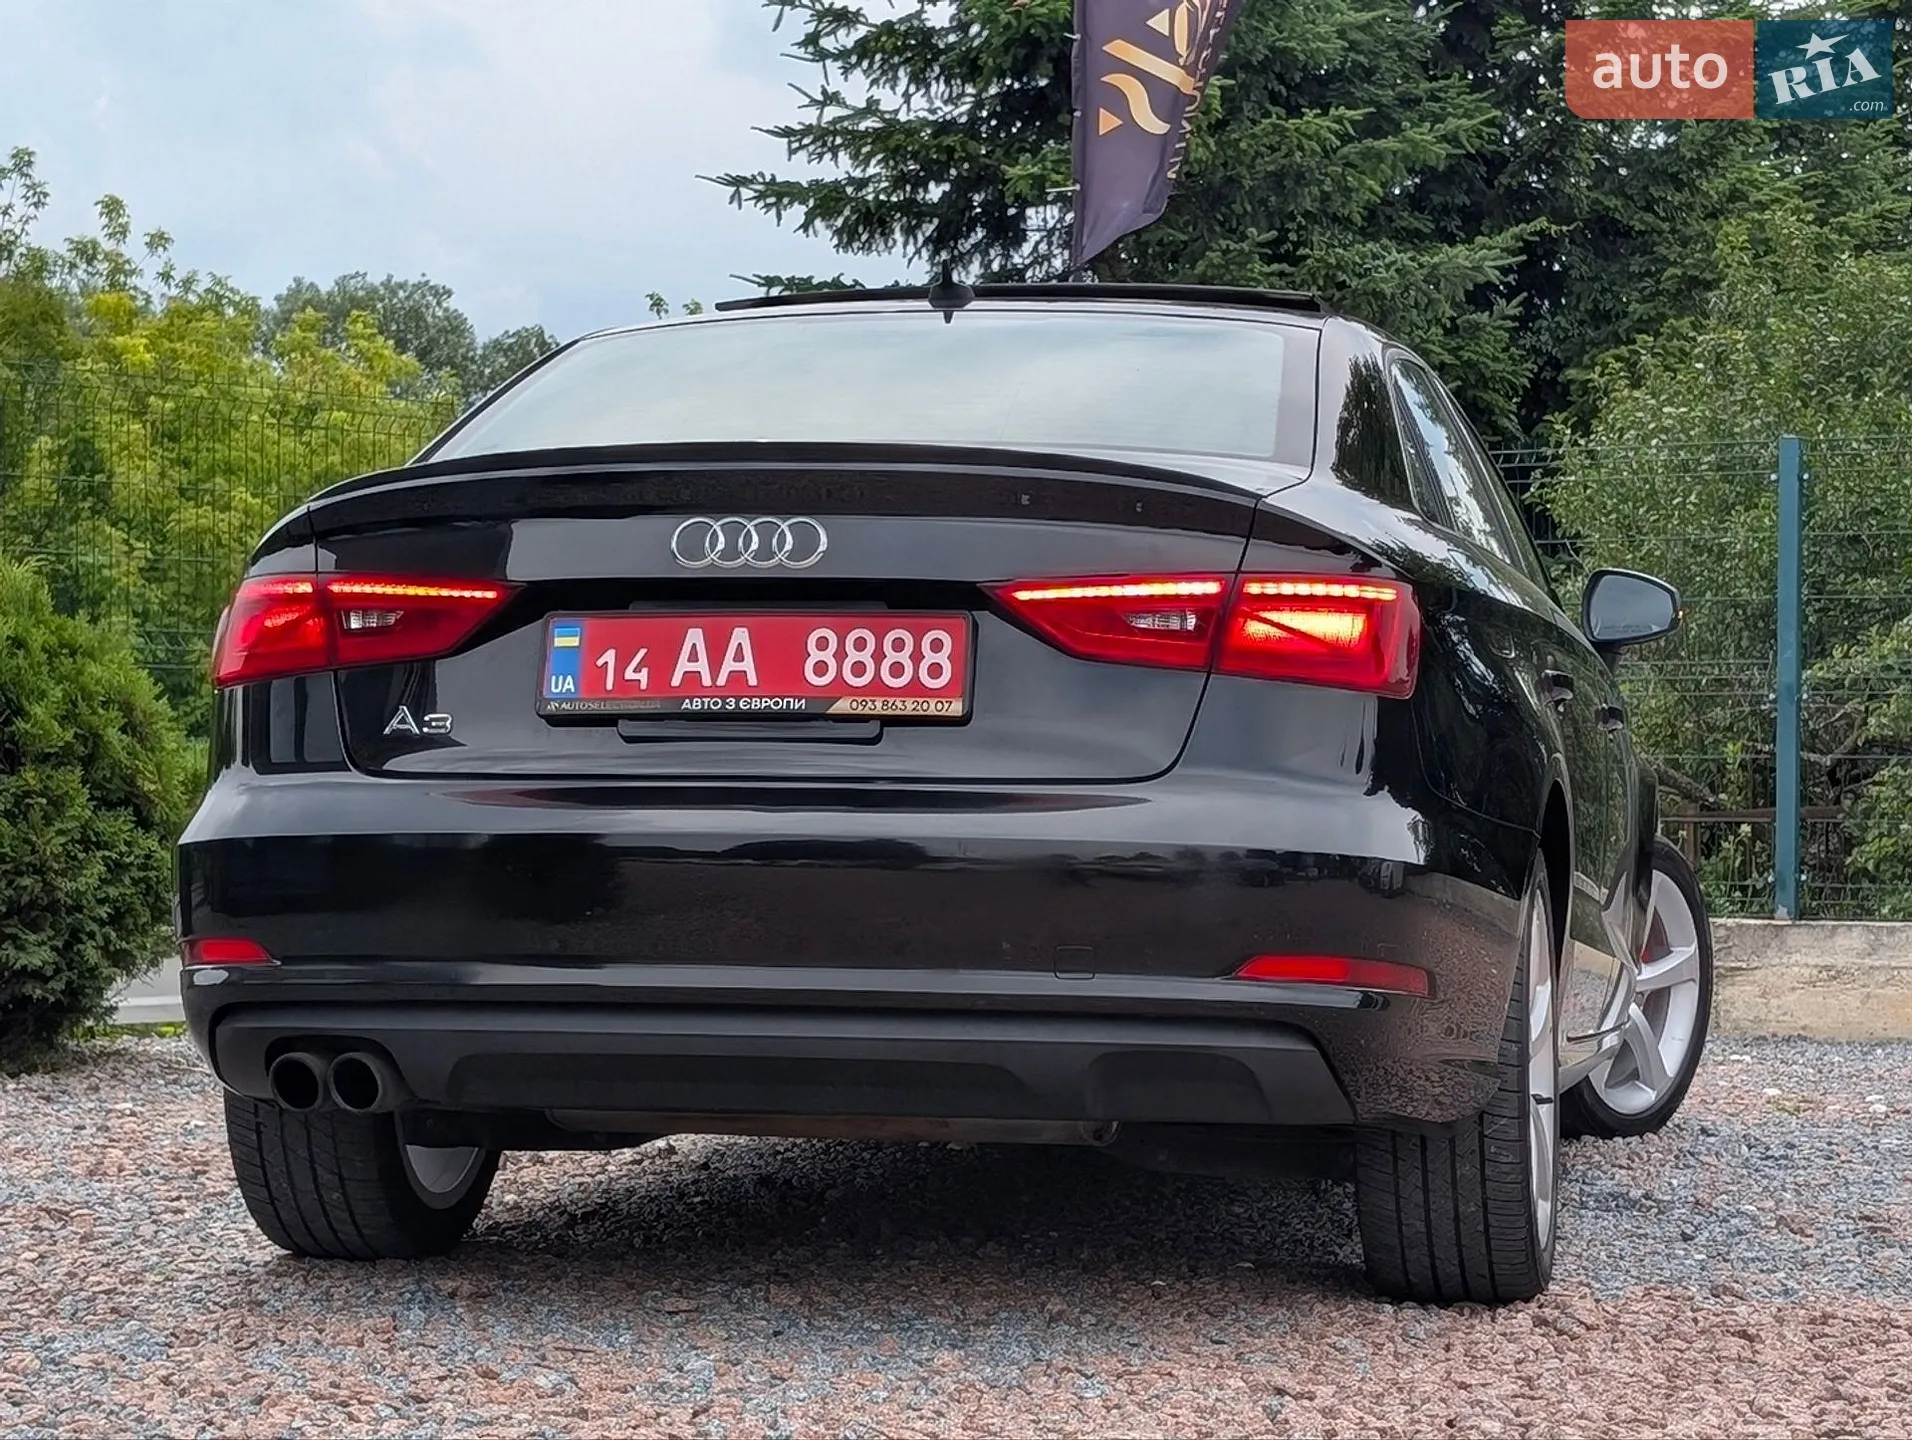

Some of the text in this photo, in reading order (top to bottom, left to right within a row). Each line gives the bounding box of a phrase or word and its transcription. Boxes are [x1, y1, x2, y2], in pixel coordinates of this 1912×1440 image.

[595, 648, 649, 691] 14
[804, 627, 953, 689] 8888
[550, 675, 575, 693] UA
[681, 697, 722, 710] АВТО
[739, 697, 806, 710] ЄВРОПИ
[849, 698, 953, 713] 093 863 20 07
[383, 705, 452, 735] A3
